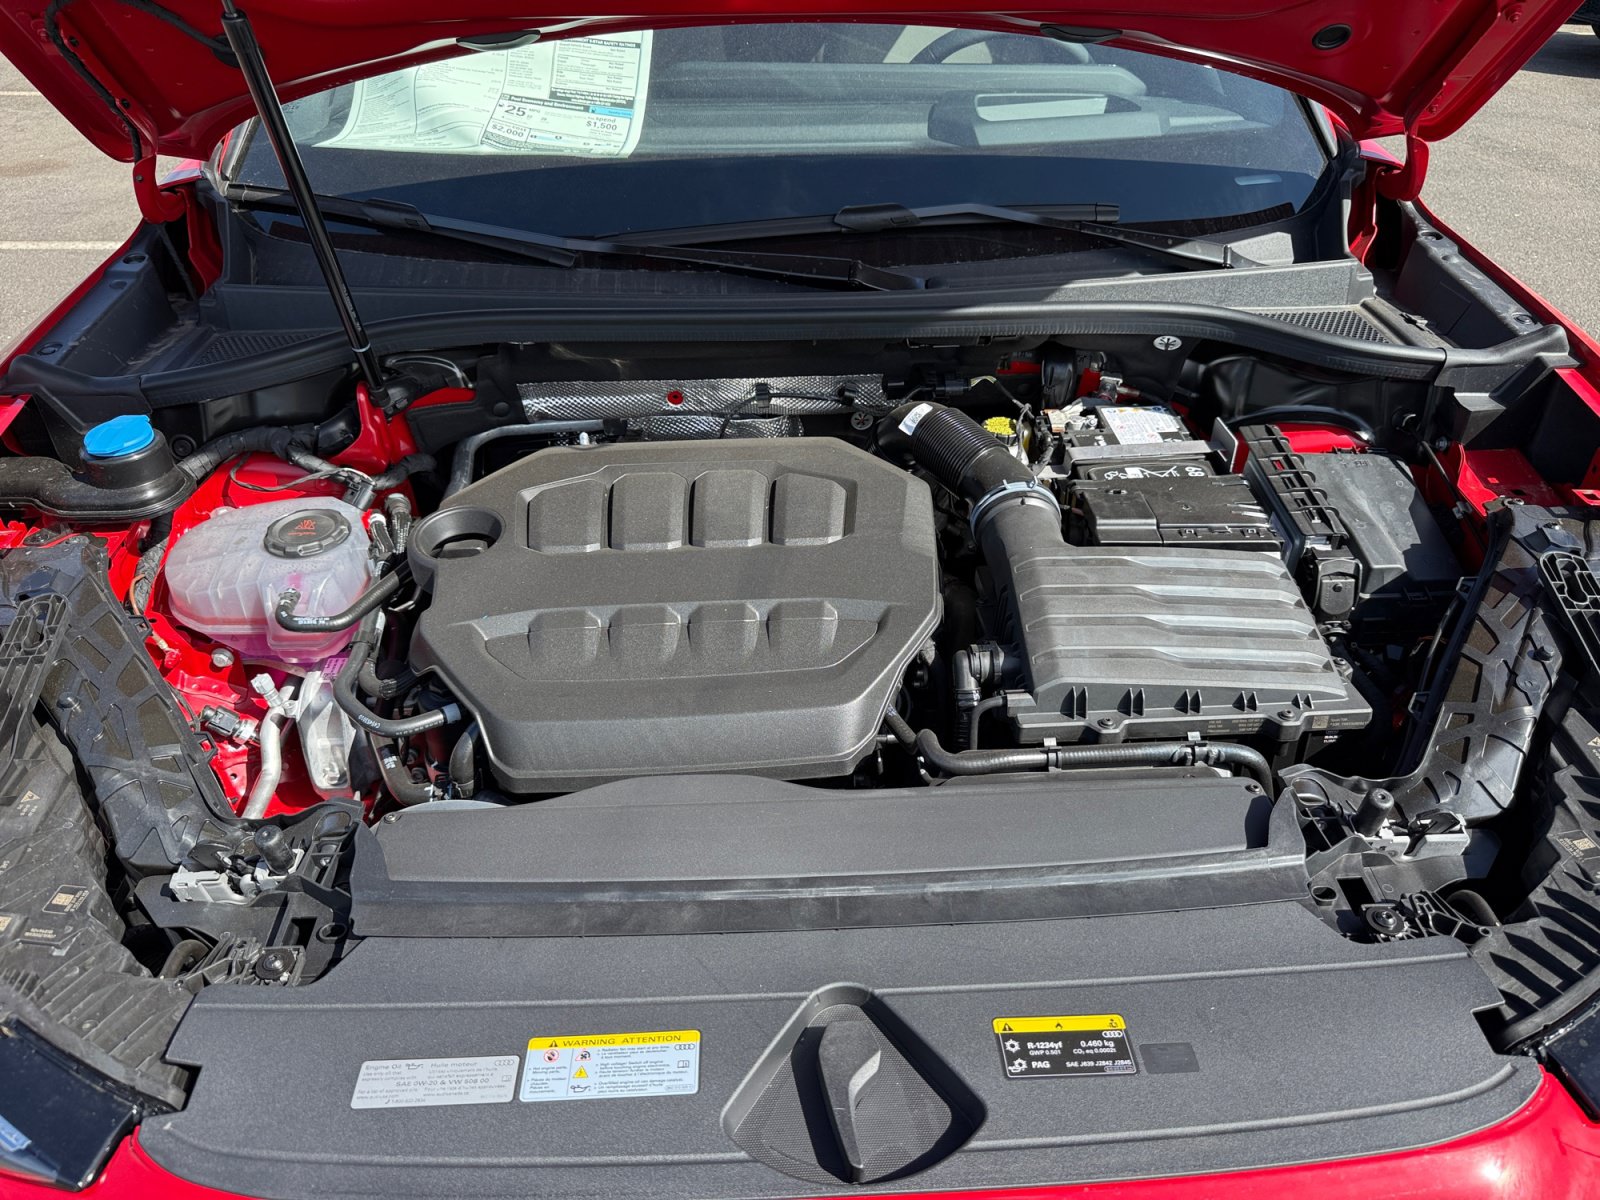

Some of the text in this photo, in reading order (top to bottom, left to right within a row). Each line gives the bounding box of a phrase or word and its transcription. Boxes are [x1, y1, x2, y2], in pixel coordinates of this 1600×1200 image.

[504, 105, 527, 117] 25
[491, 124, 524, 138] $2,000
[585, 120, 618, 131] $1,500
[563, 1035, 682, 1047] WARNING ATTENTION
[1026, 1041, 1063, 1049] R-1234yf
[1103, 1039, 1115, 1048] kg
[1031, 1060, 1051, 1069] PAG
[412, 1079, 438, 1087] 0W-20
